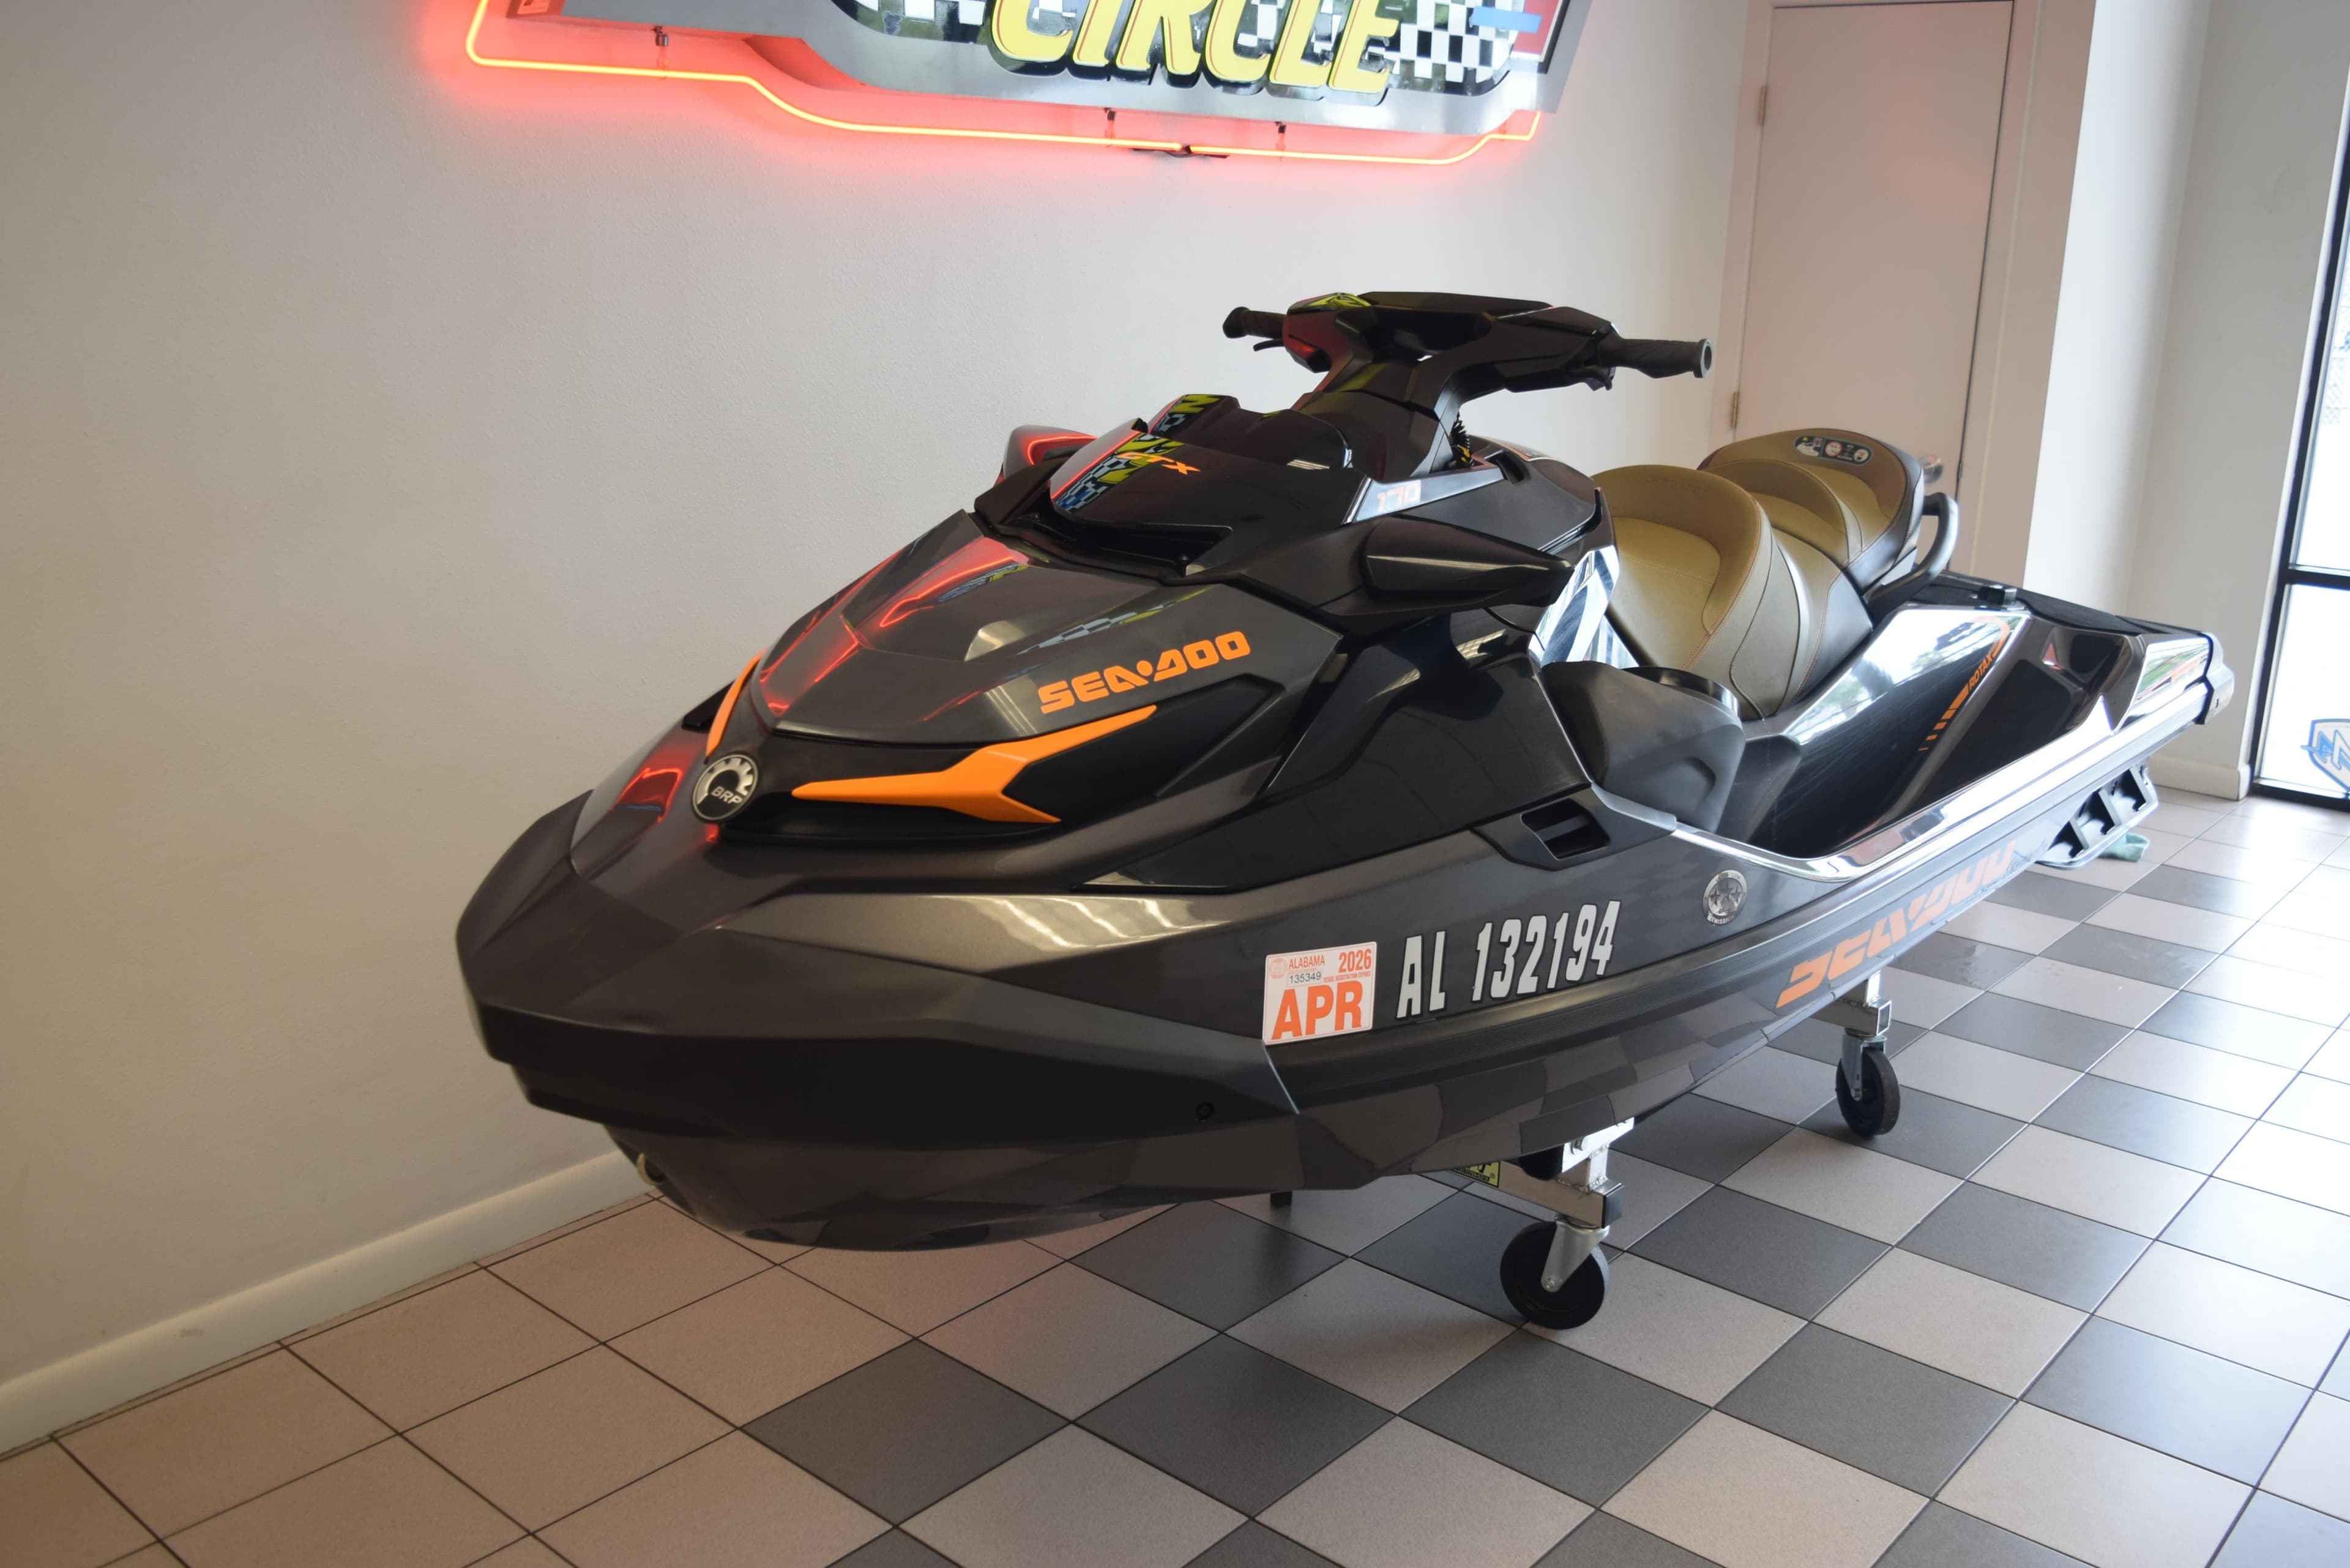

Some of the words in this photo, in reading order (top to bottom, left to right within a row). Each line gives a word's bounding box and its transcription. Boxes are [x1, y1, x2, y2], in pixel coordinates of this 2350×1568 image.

[1116, 452, 1201, 475] GTX
[1377, 483, 1421, 512] 170
[1969, 652, 1993, 691] ROTAX
[711, 786, 743, 804] BRP
[1288, 955, 1325, 969] ALABAMA
[1338, 949, 1371, 973] 2026
[1396, 930, 1446, 1018] AL
[1472, 900, 1621, 1002] 132194
[1289, 971, 1322, 984] 135349
[1271, 980, 1363, 1040] APR
